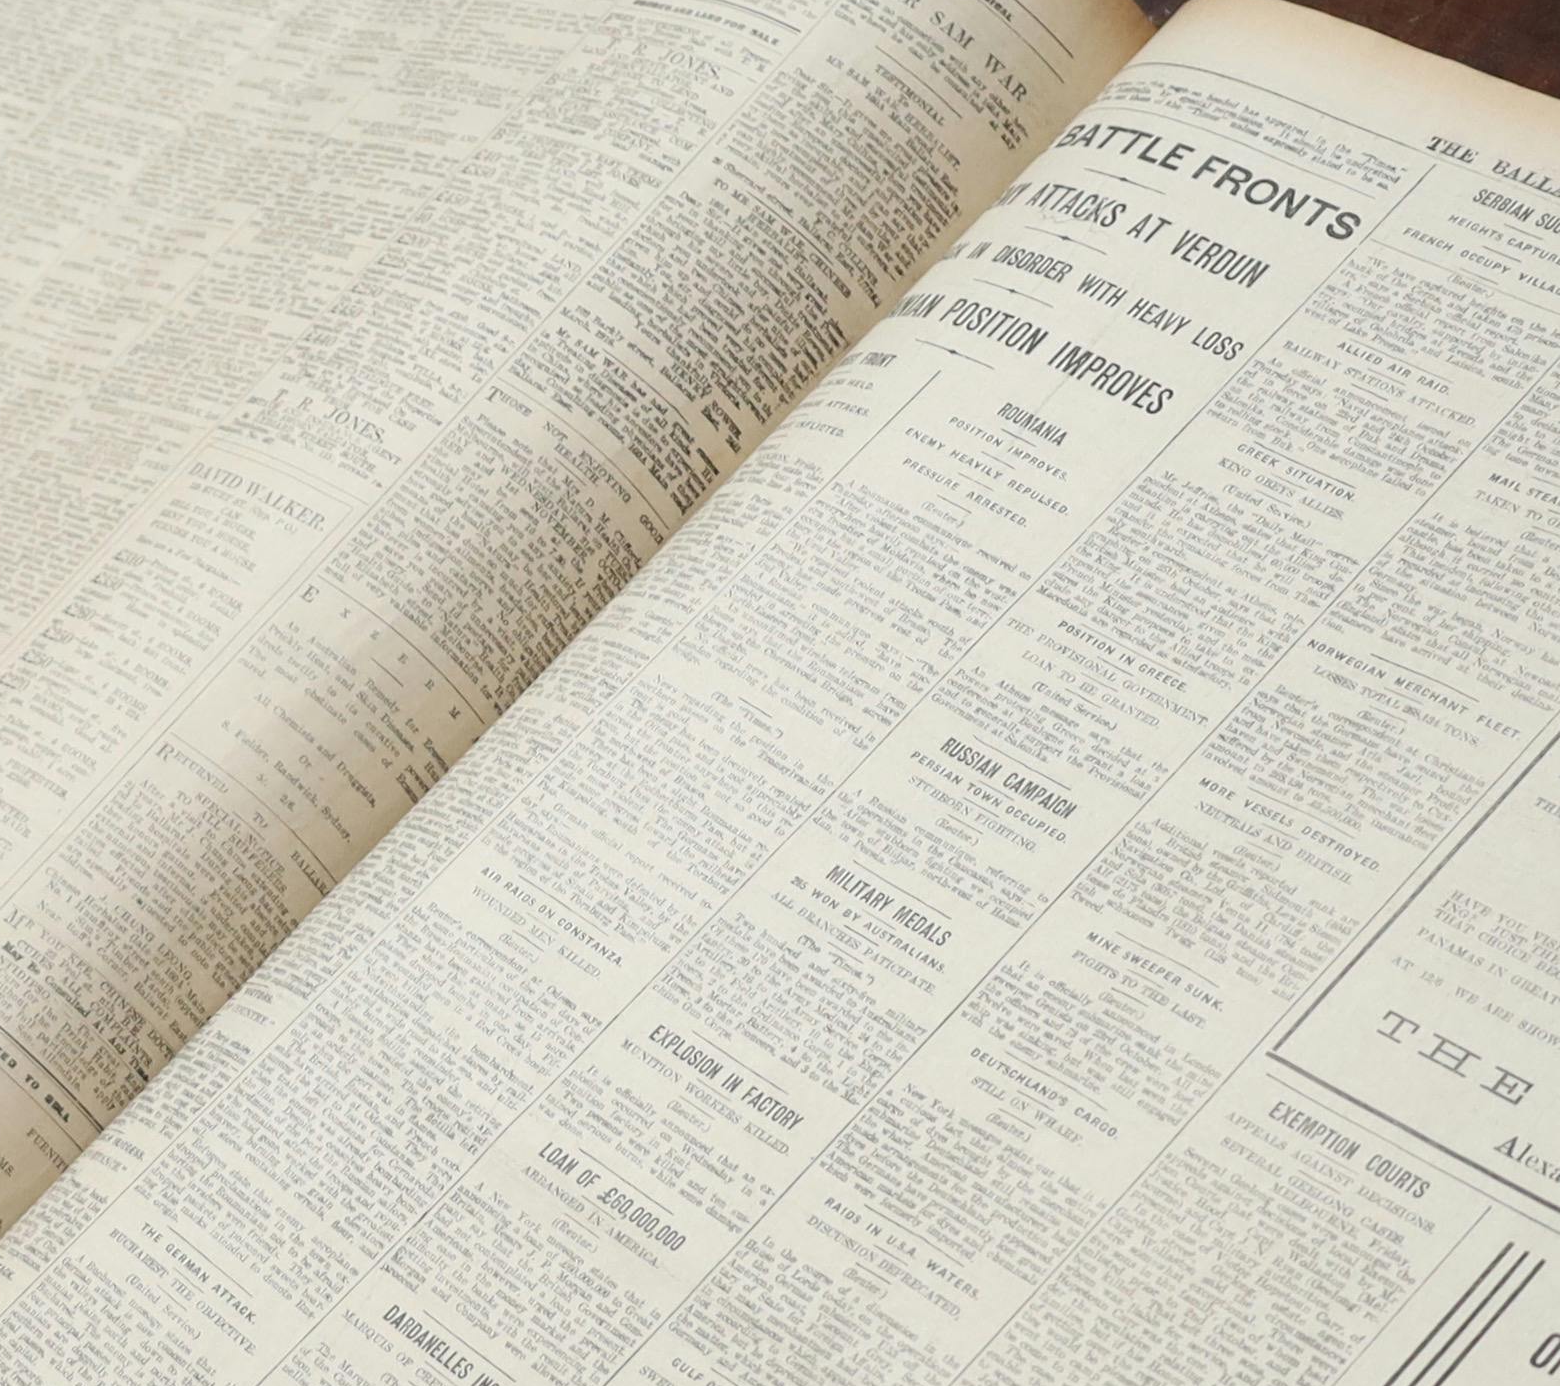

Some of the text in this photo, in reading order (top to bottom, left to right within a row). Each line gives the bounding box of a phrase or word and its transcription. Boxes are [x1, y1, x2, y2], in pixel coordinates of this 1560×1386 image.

[928, 10, 976, 51] SAM
[983, 51, 1029, 103] WAR
[1053, 124, 1363, 242] BATTLE FRONTS
[1424, 134, 1480, 165] THE
[1024, 183, 1129, 229] ATTACKS
[1124, 212, 1174, 245] AT
[1169, 228, 1272, 290] VERDUN
[1471, 187, 1537, 224] SERBIAN
[970, 241, 997, 263] IN
[990, 243, 1075, 285] DISORDER
[1075, 272, 1130, 309] WITH
[1125, 296, 1193, 337] HEAVY
[1190, 325, 1246, 362] LOSS
[937, 297, 1175, 416] POSITION IMPROVES
[903, 426, 1070, 517] ENEMY HEAVILY REPULSED.
[995, 400, 1069, 448] ROUMANIA
[938, 735, 1079, 821] RUSSIAN CAMPAIGN
[824, 863, 954, 948] MILITARY MEDALS
[647, 1023, 806, 1132] EXPLOSION IN FACTORY
[1375, 1008, 1536, 1107] THE
[536, 1140, 688, 1253] LOAN OF £60,000,000
[1267, 1099, 1432, 1200] EXEMPTION COURTS
[381, 1303, 476, 1381] DARDANELLES
